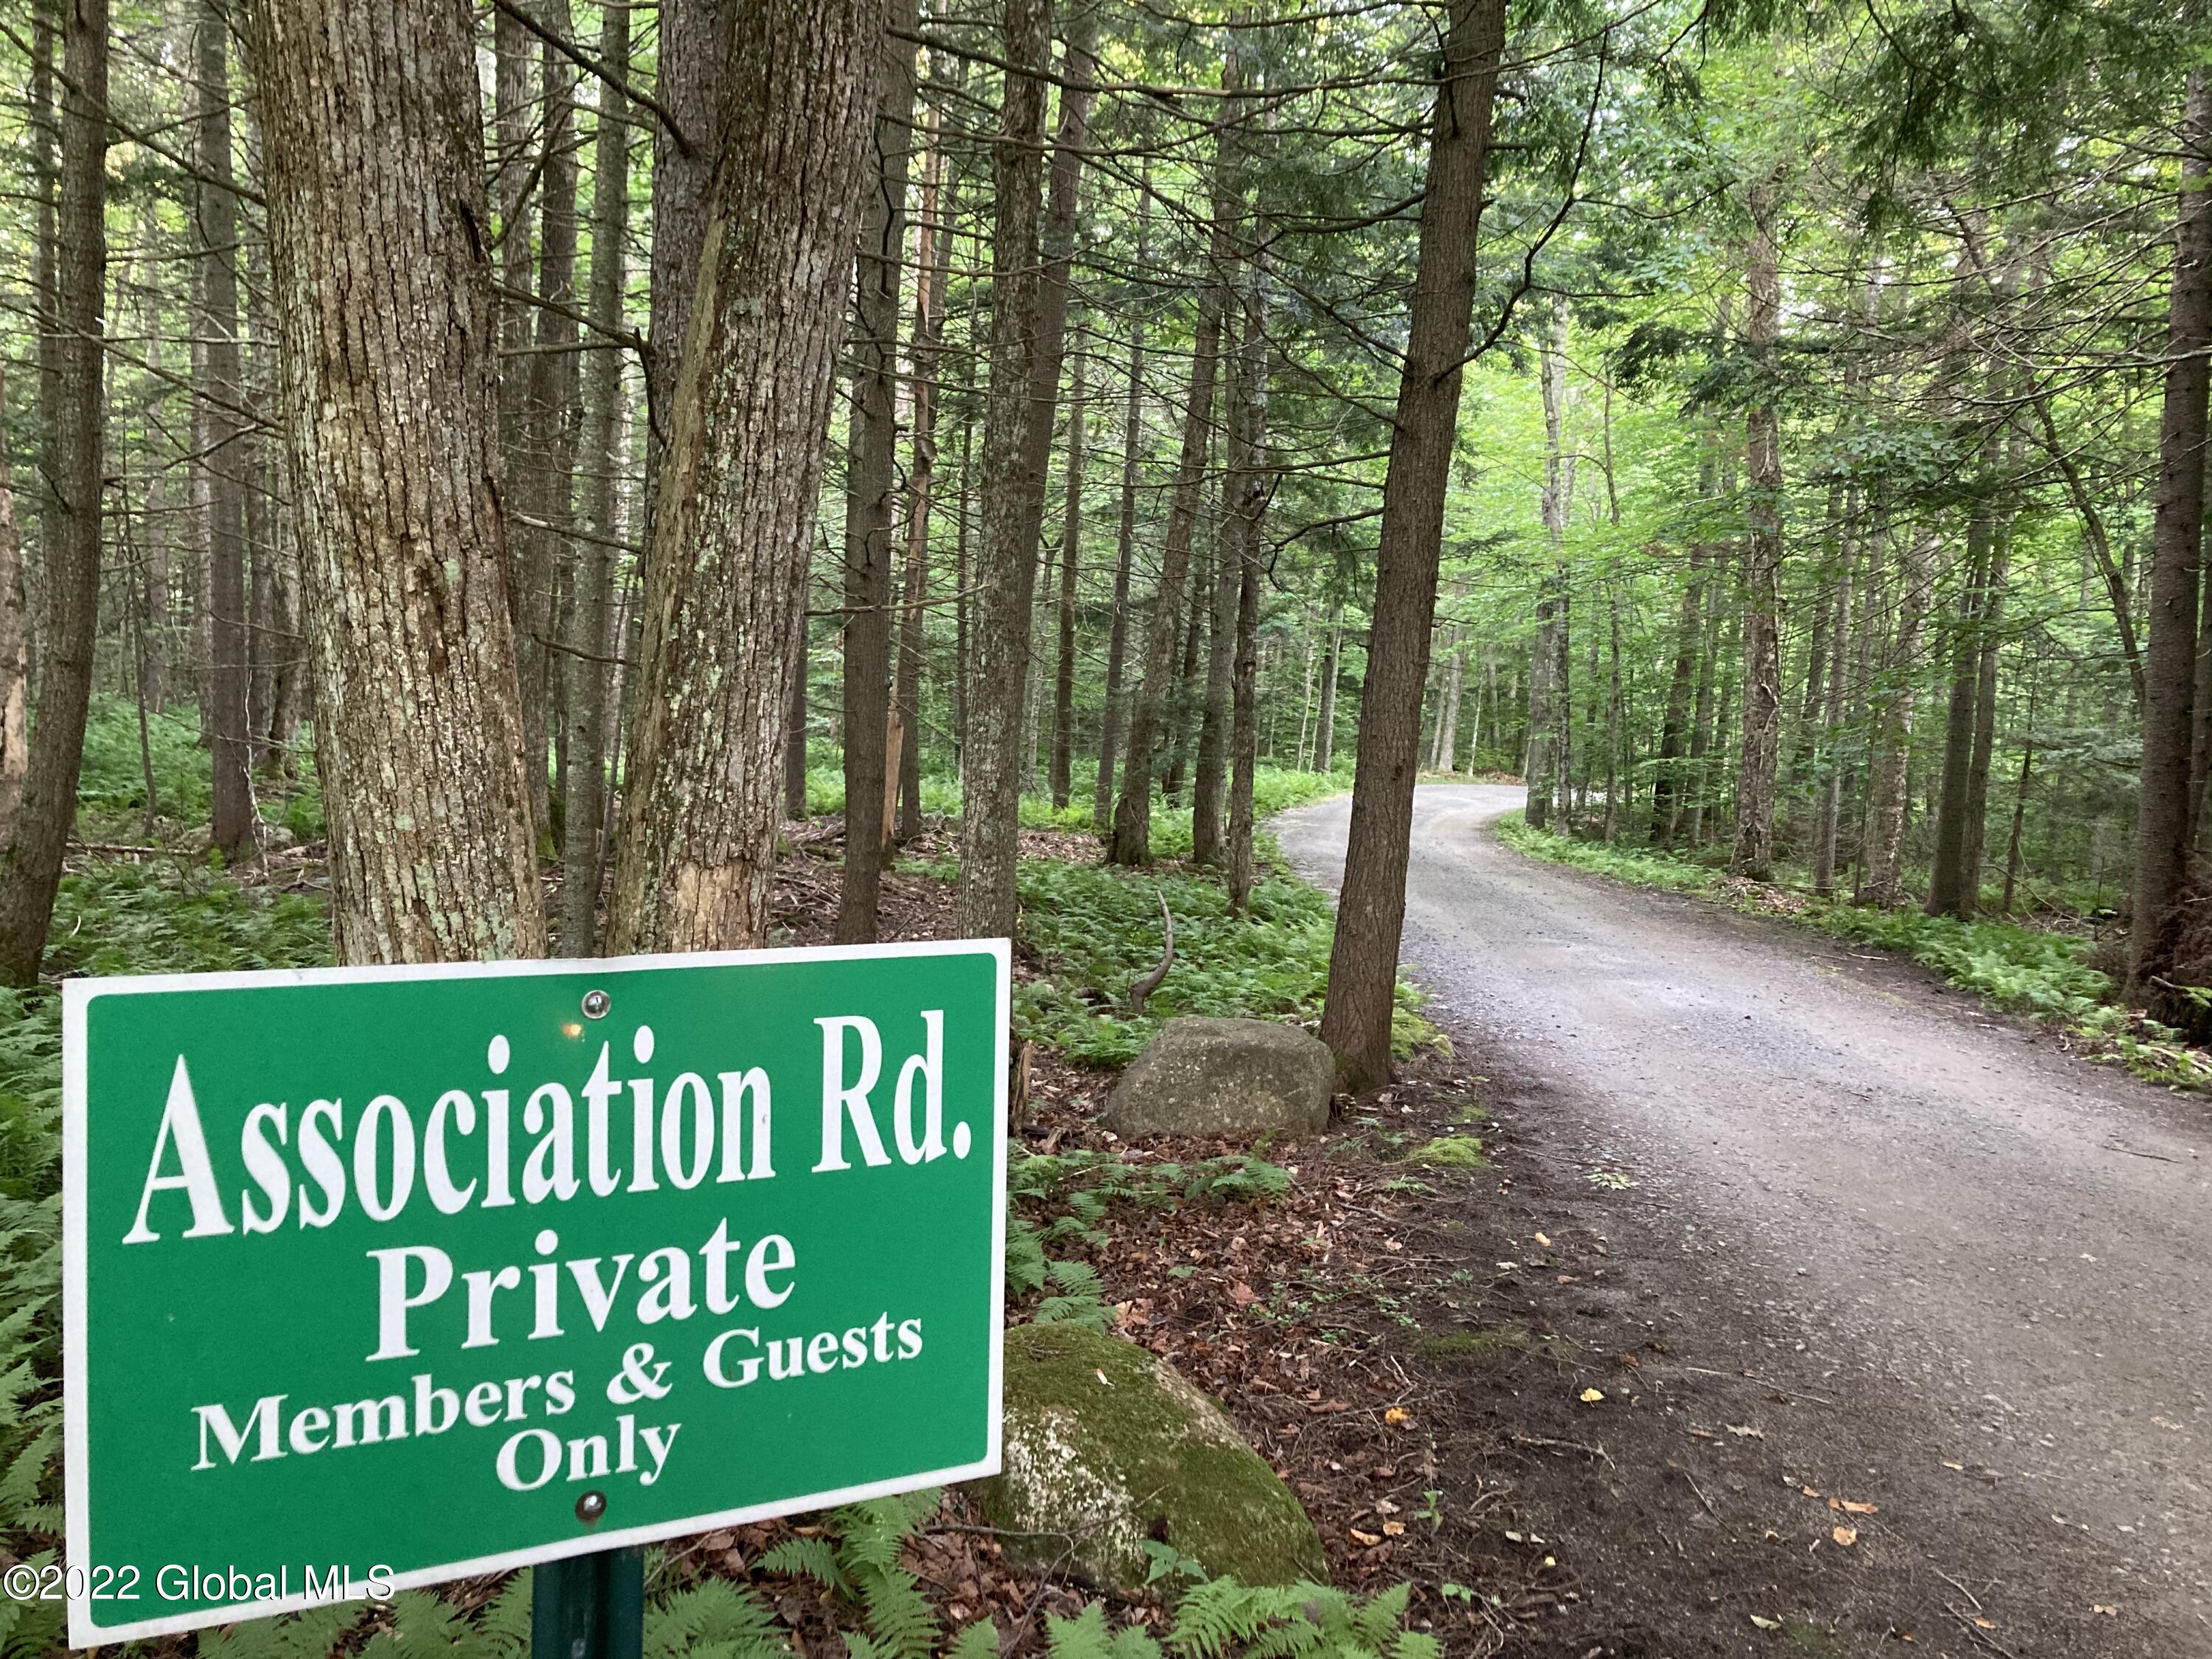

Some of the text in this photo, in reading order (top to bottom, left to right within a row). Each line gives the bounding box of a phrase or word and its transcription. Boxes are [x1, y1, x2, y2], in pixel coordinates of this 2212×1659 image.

[122, 1010, 972, 1245] Association Rd.
[366, 1218, 796, 1362] Private
[191, 1312, 923, 1471] Members & Guests
[495, 1415, 681, 1491] Only
